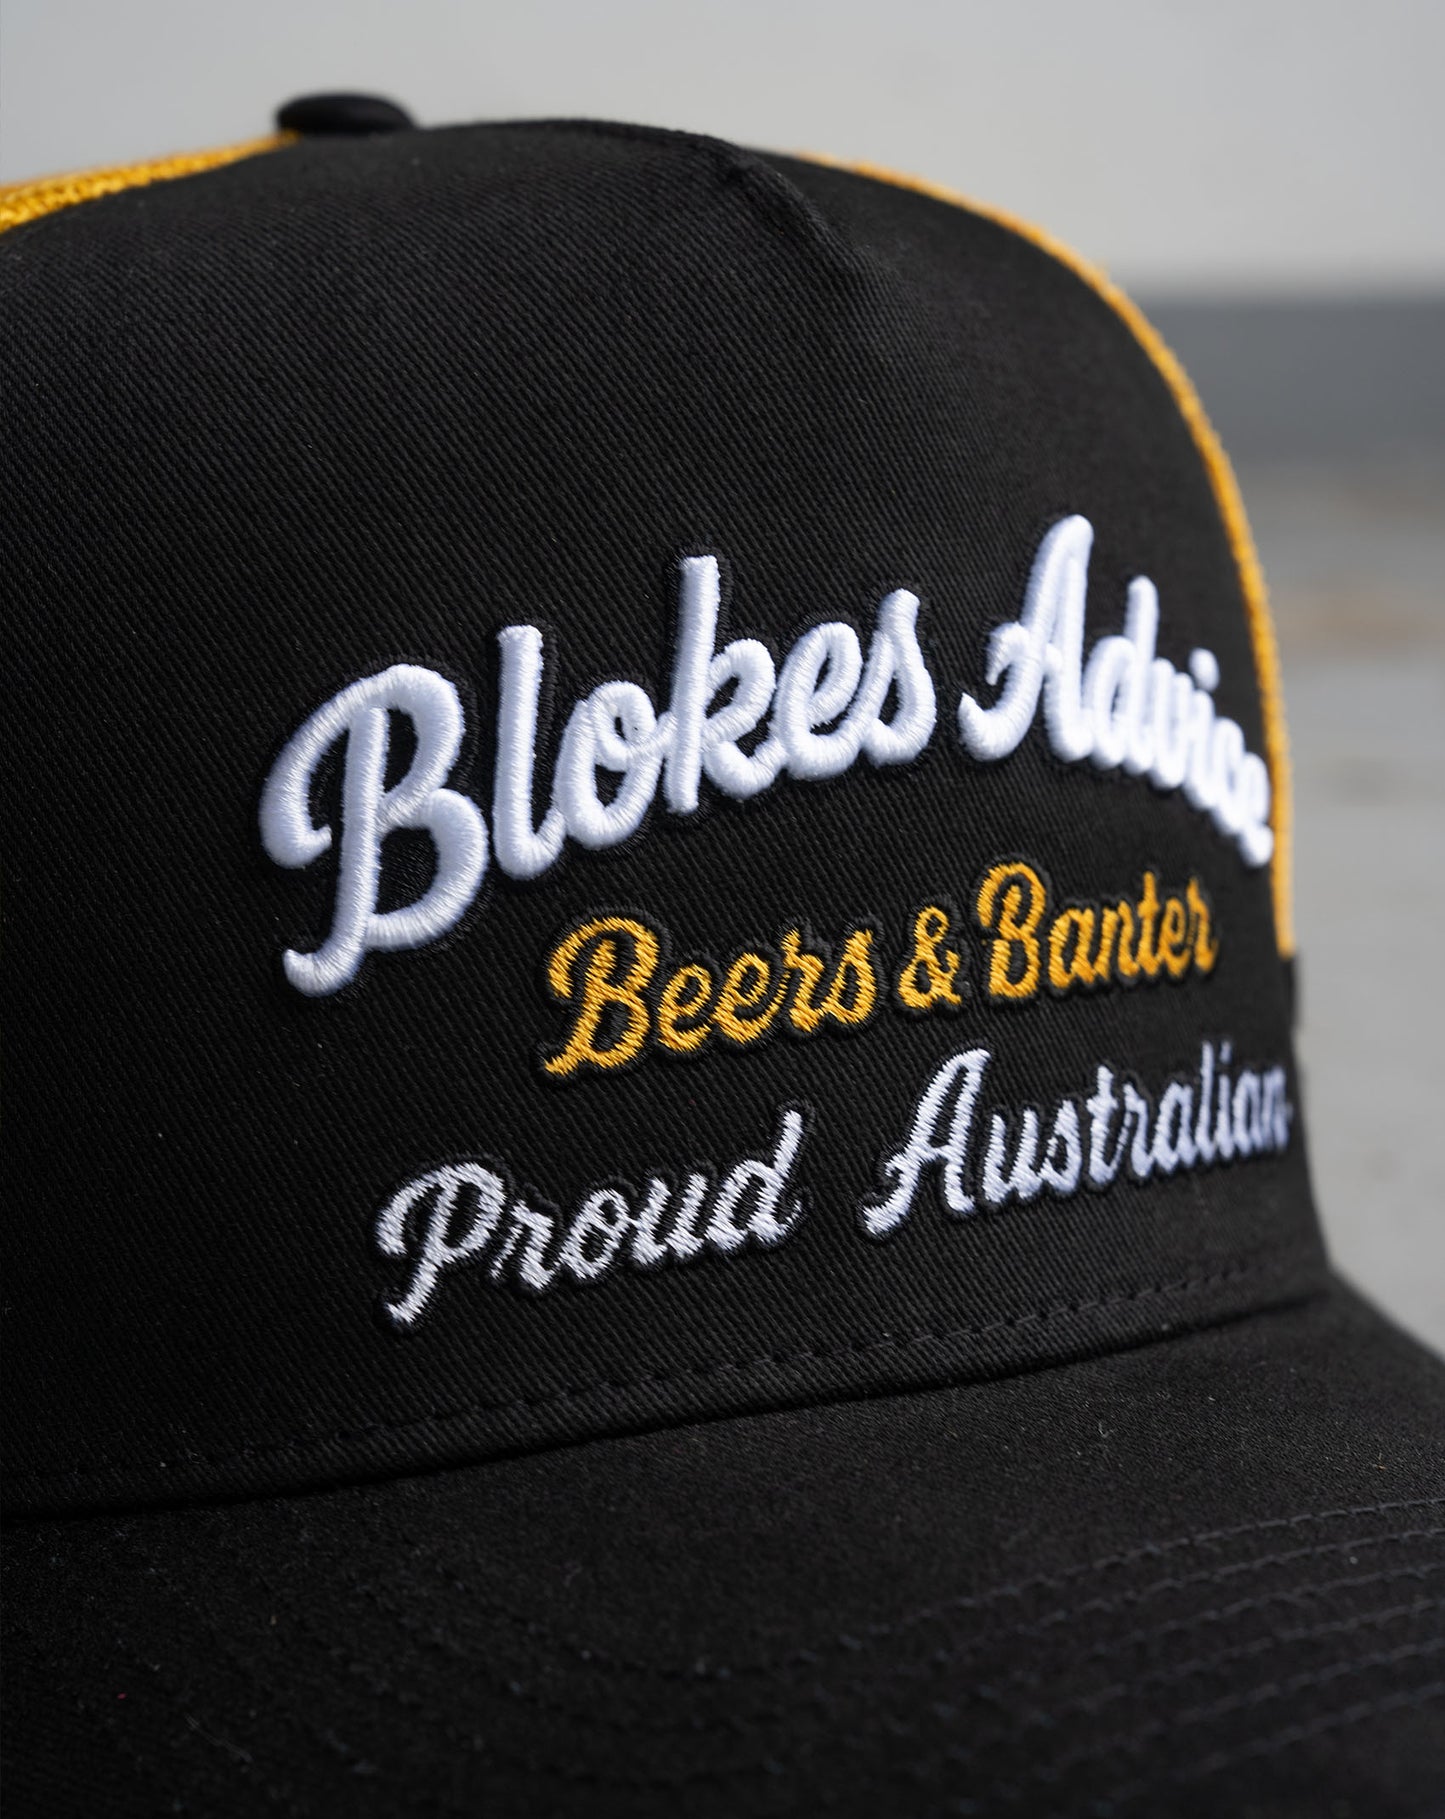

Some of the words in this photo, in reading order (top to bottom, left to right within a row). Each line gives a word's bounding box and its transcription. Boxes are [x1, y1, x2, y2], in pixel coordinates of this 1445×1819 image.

[259, 555, 937, 996] Blokes
[545, 917, 875, 1076] Beers
[902, 907, 962, 1010] &
[976, 862, 1217, 998] Banter
[376, 1110, 803, 1324] Proud
[864, 1040, 1292, 1235] Australian
